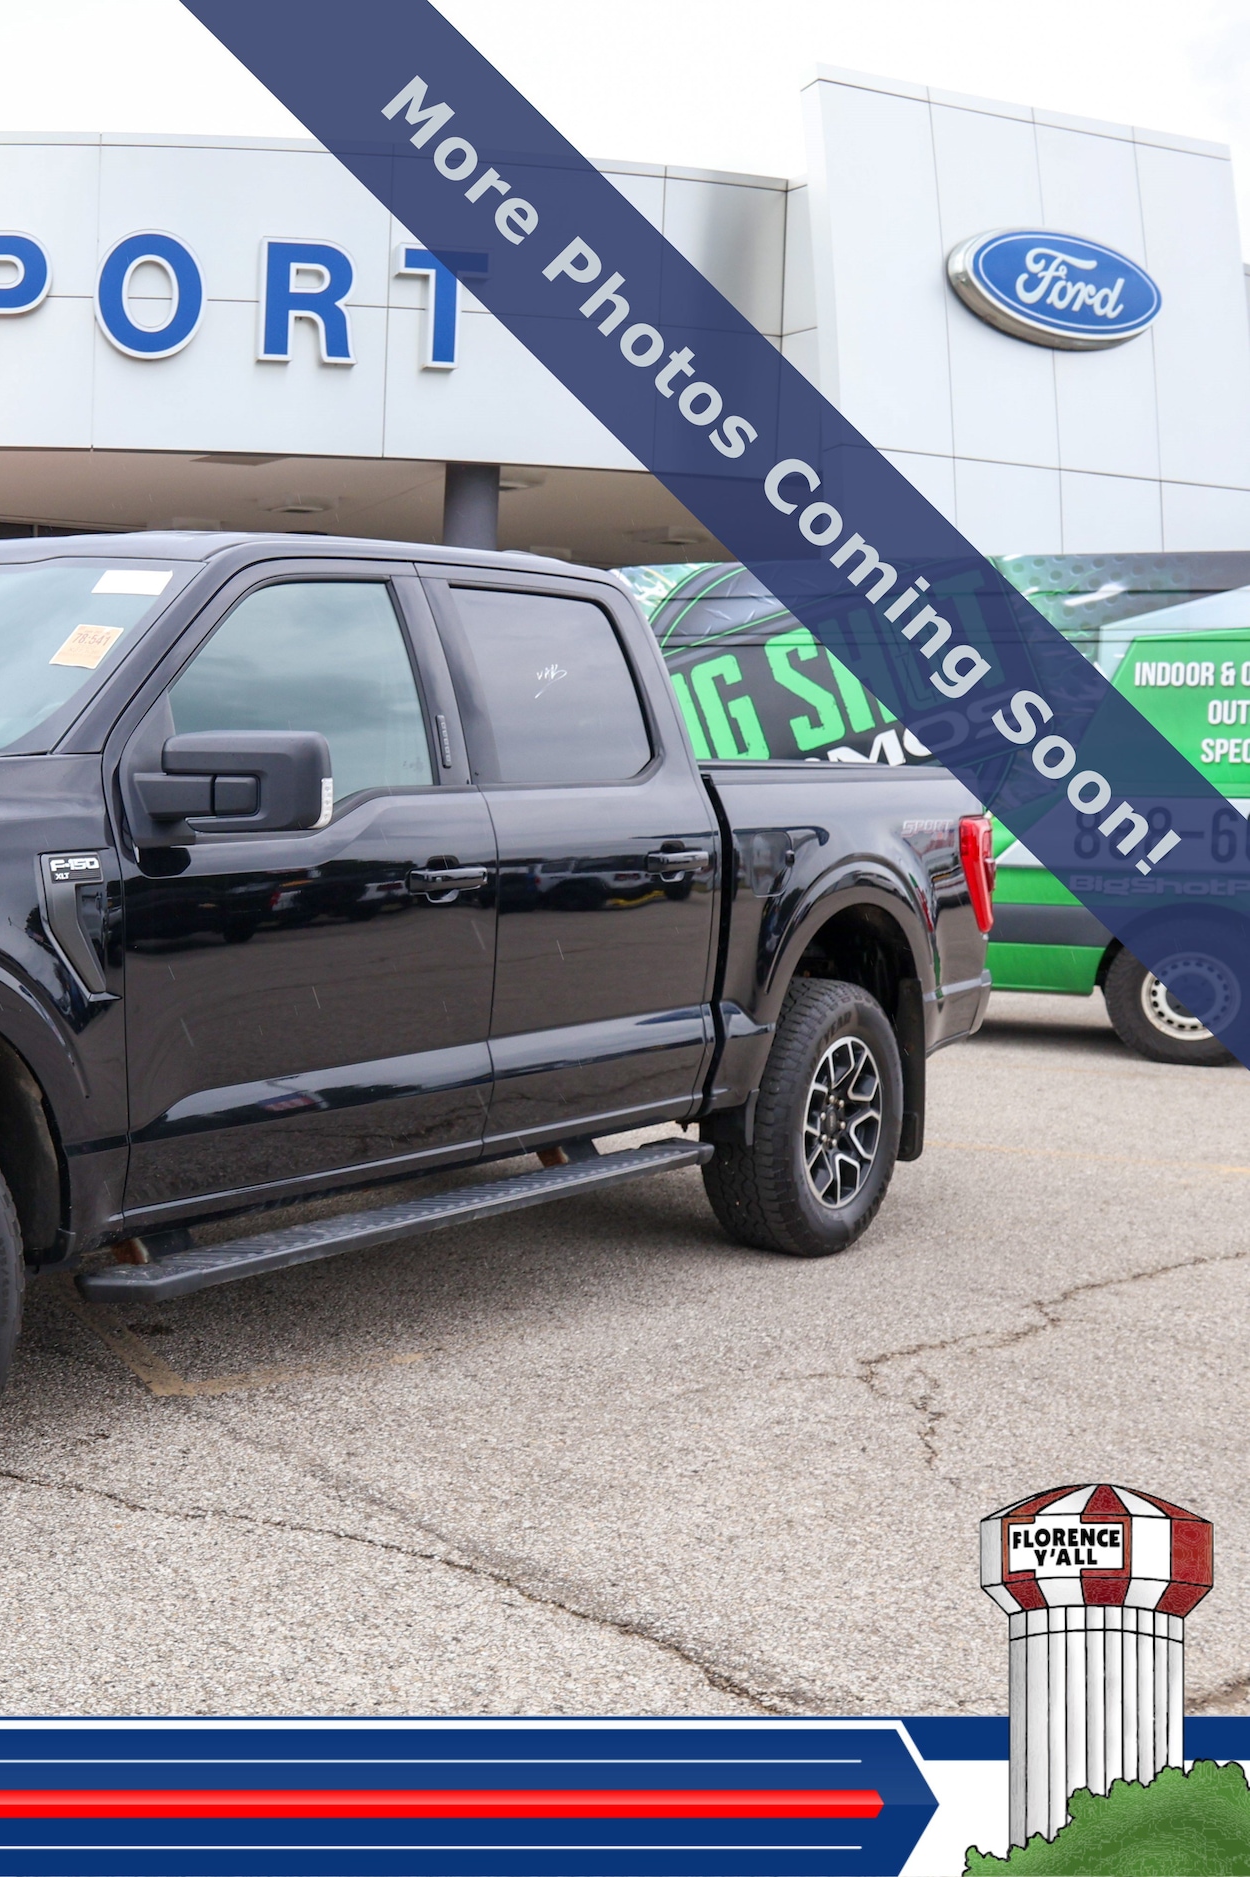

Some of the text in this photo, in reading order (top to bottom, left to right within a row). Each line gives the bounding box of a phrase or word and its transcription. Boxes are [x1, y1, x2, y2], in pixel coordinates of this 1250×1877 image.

[1015, 247, 1125, 319] Ford
[1133, 661, 1215, 687] INDOOR
[1220, 661, 1236, 687] &
[901, 819, 955, 836] SPORT
[50, 857, 100, 872] F-150
[55, 872, 70, 880] XLT
